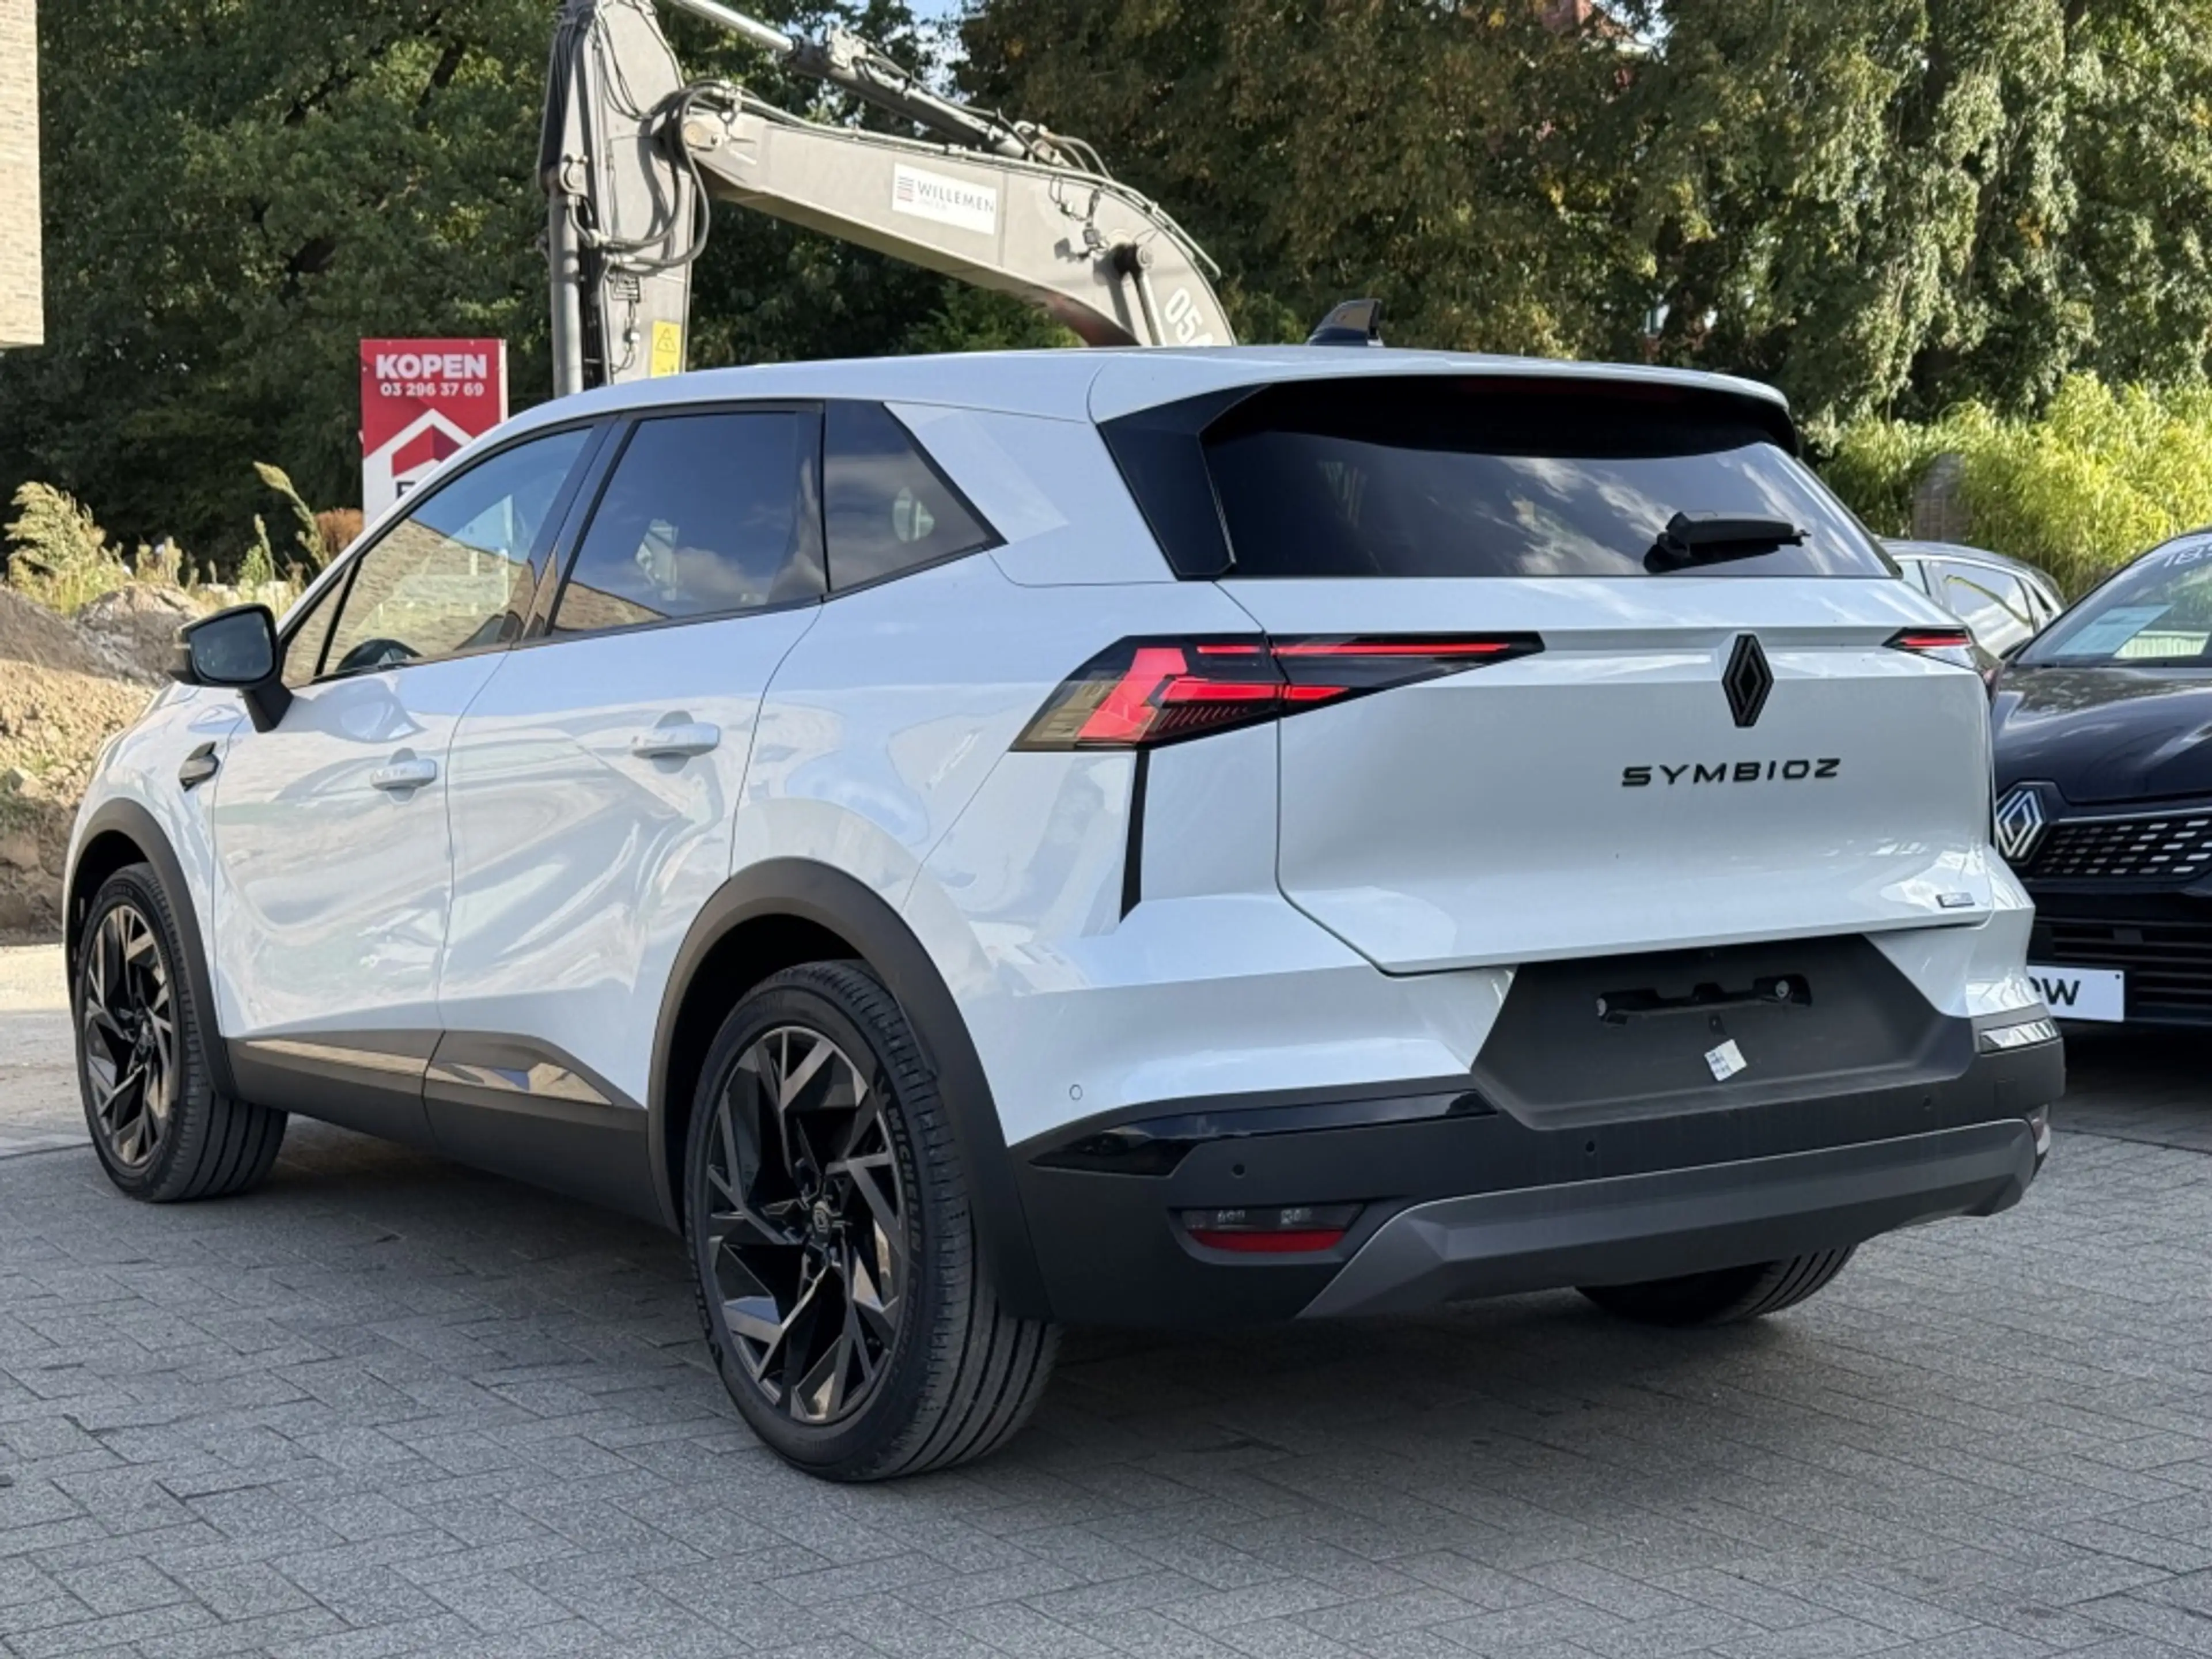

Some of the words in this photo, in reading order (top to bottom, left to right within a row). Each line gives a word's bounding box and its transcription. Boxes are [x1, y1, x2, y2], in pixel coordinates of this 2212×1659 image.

[917, 180, 994, 213] WILLEMEN
[376, 353, 487, 380] KOPEN
[380, 382, 403, 397] 03
[440, 382, 459, 397] 37
[1621, 757, 1842, 787] SYMBIOZ
[888, 1107, 922, 1253] MICHELIN
